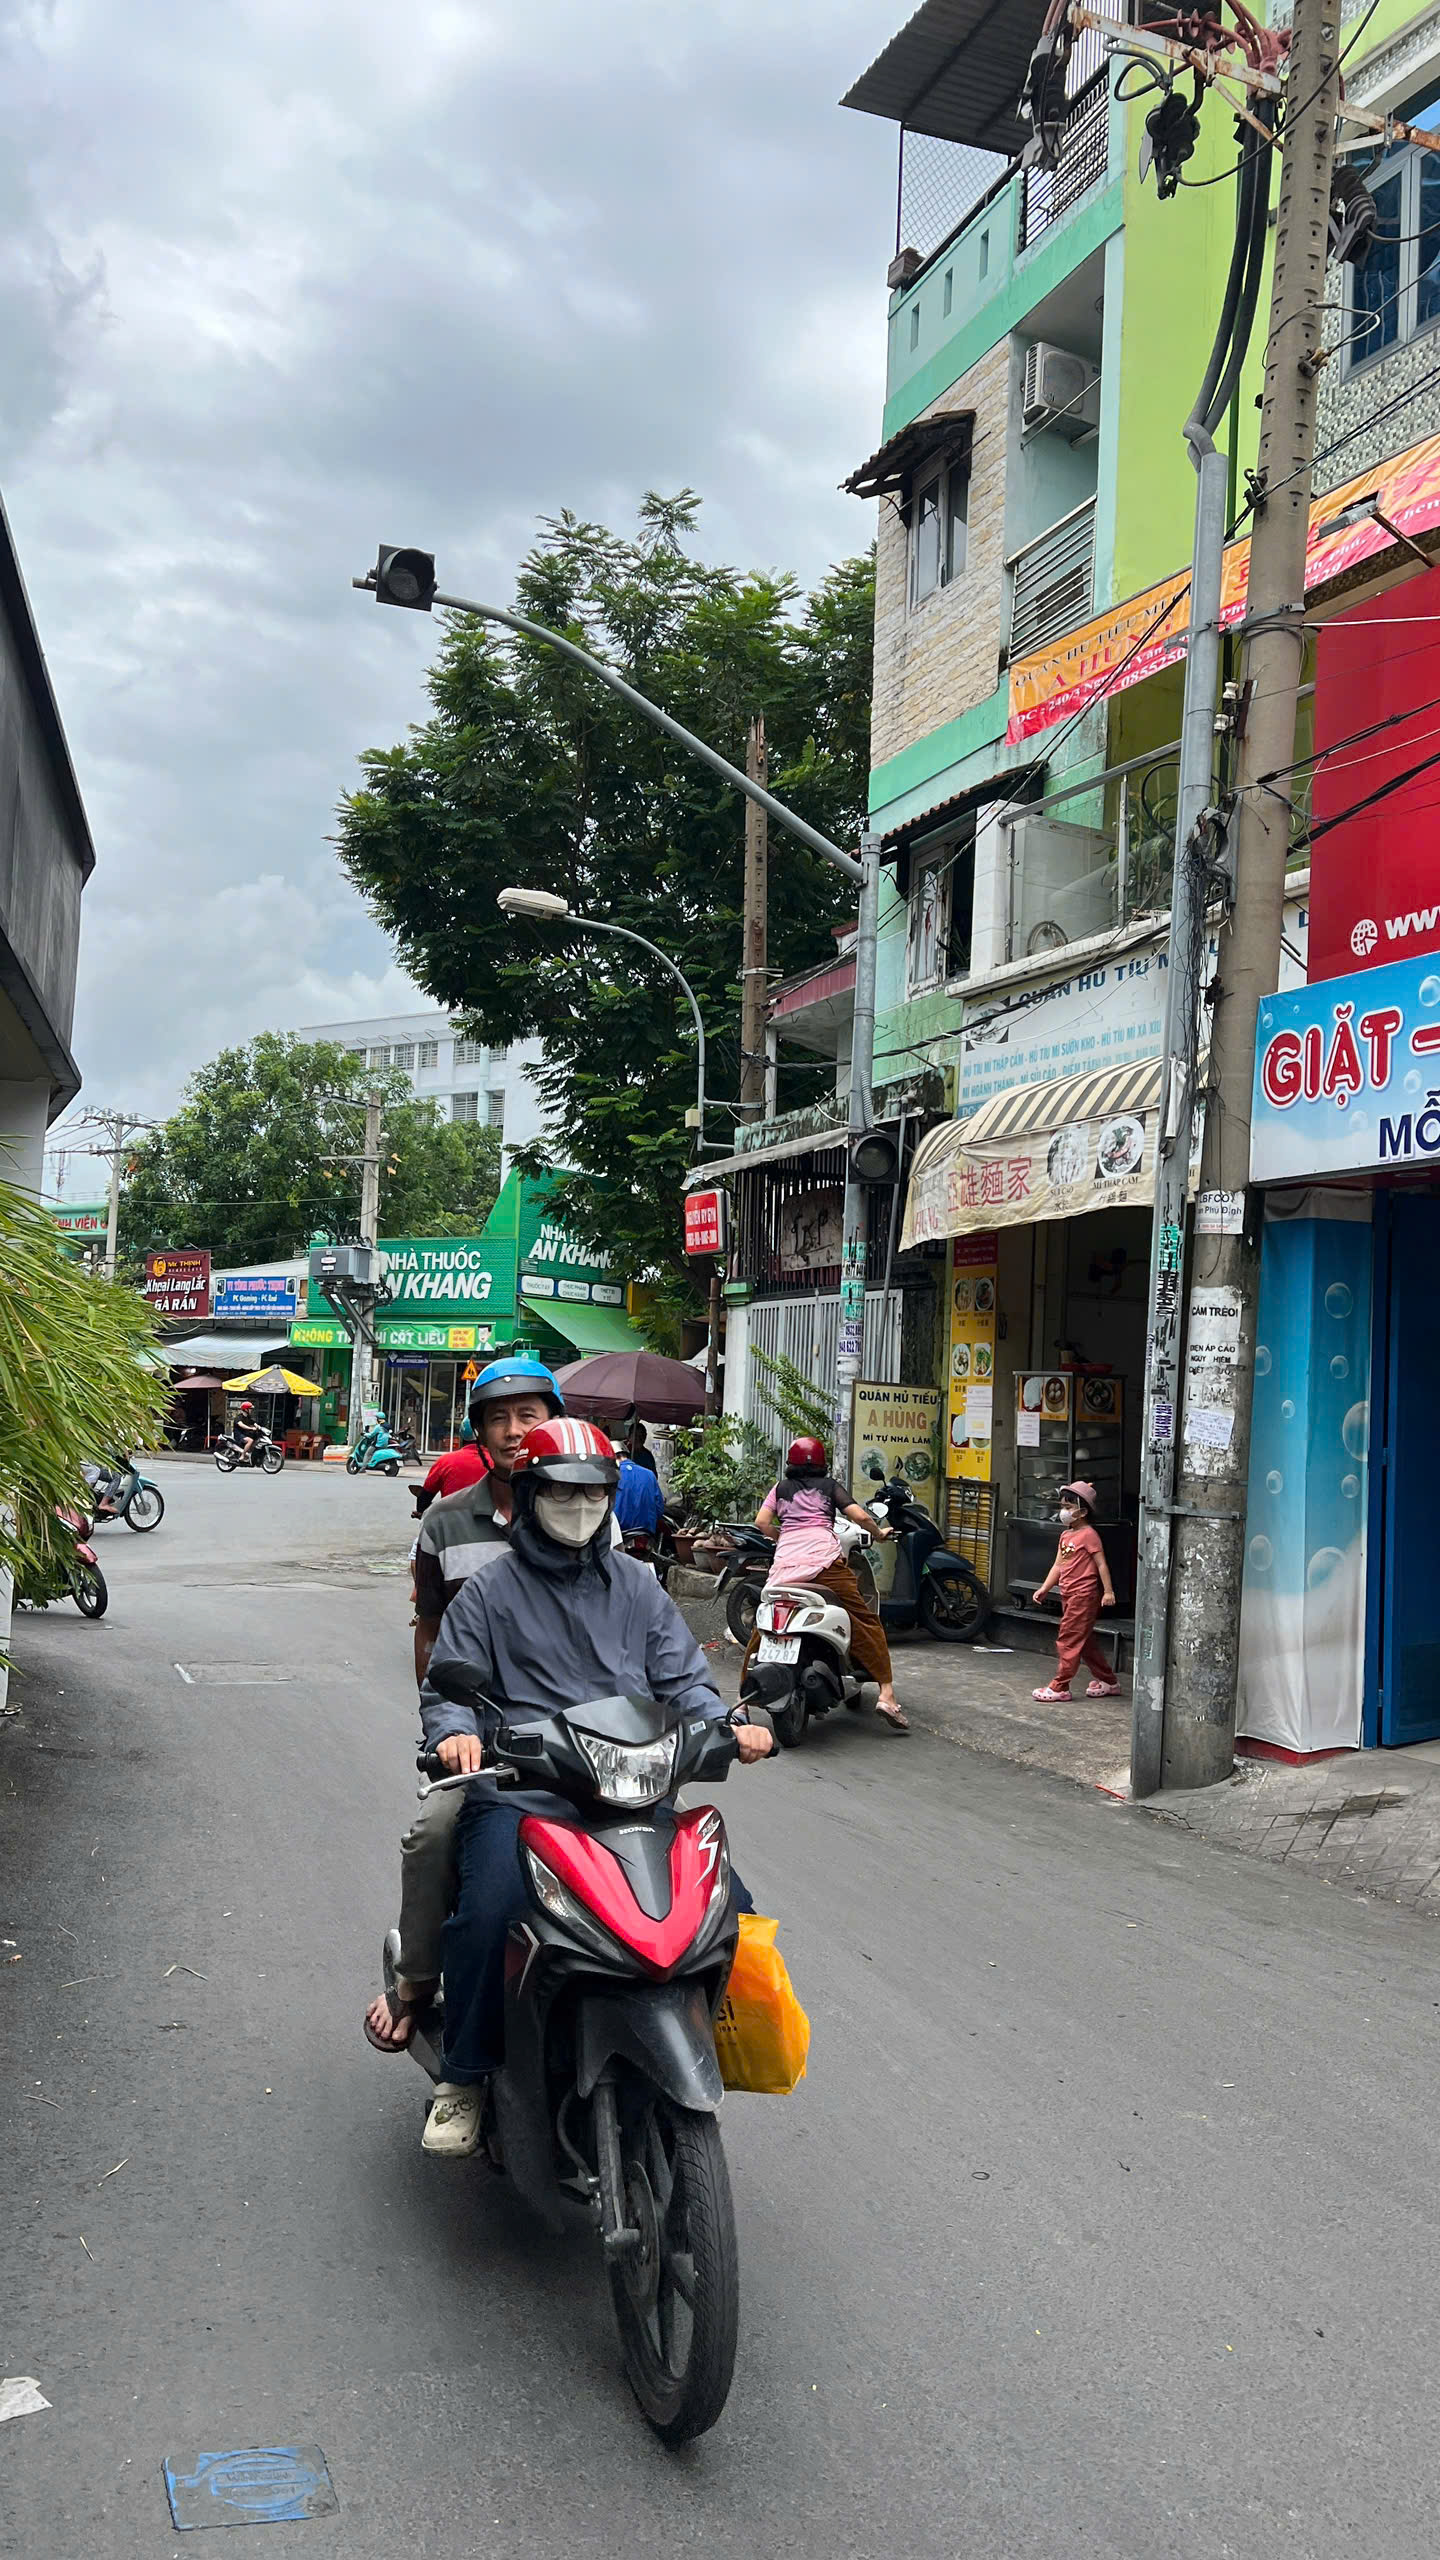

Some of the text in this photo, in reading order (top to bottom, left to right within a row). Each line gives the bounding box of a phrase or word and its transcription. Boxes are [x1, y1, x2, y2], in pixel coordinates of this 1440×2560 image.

[1262, 1001, 1403, 1109] GIẶT
[386, 1244, 481, 1271] NHÀ THUỐC
[528, 1239, 558, 1262] AN
[170, 1277, 192, 1295] Lang
[191, 1274, 206, 1291] Lắc
[404, 1271, 493, 1300] KHANG
[154, 1296, 197, 1311] GÀ RÁN
[858, 1388, 938, 1405] QUÁN HỦ TIẾU
[867, 1405, 928, 1430] A HÙNG
[876, 1434, 889, 1444] TỰ
[618, 1826, 656, 1835] HONDA
